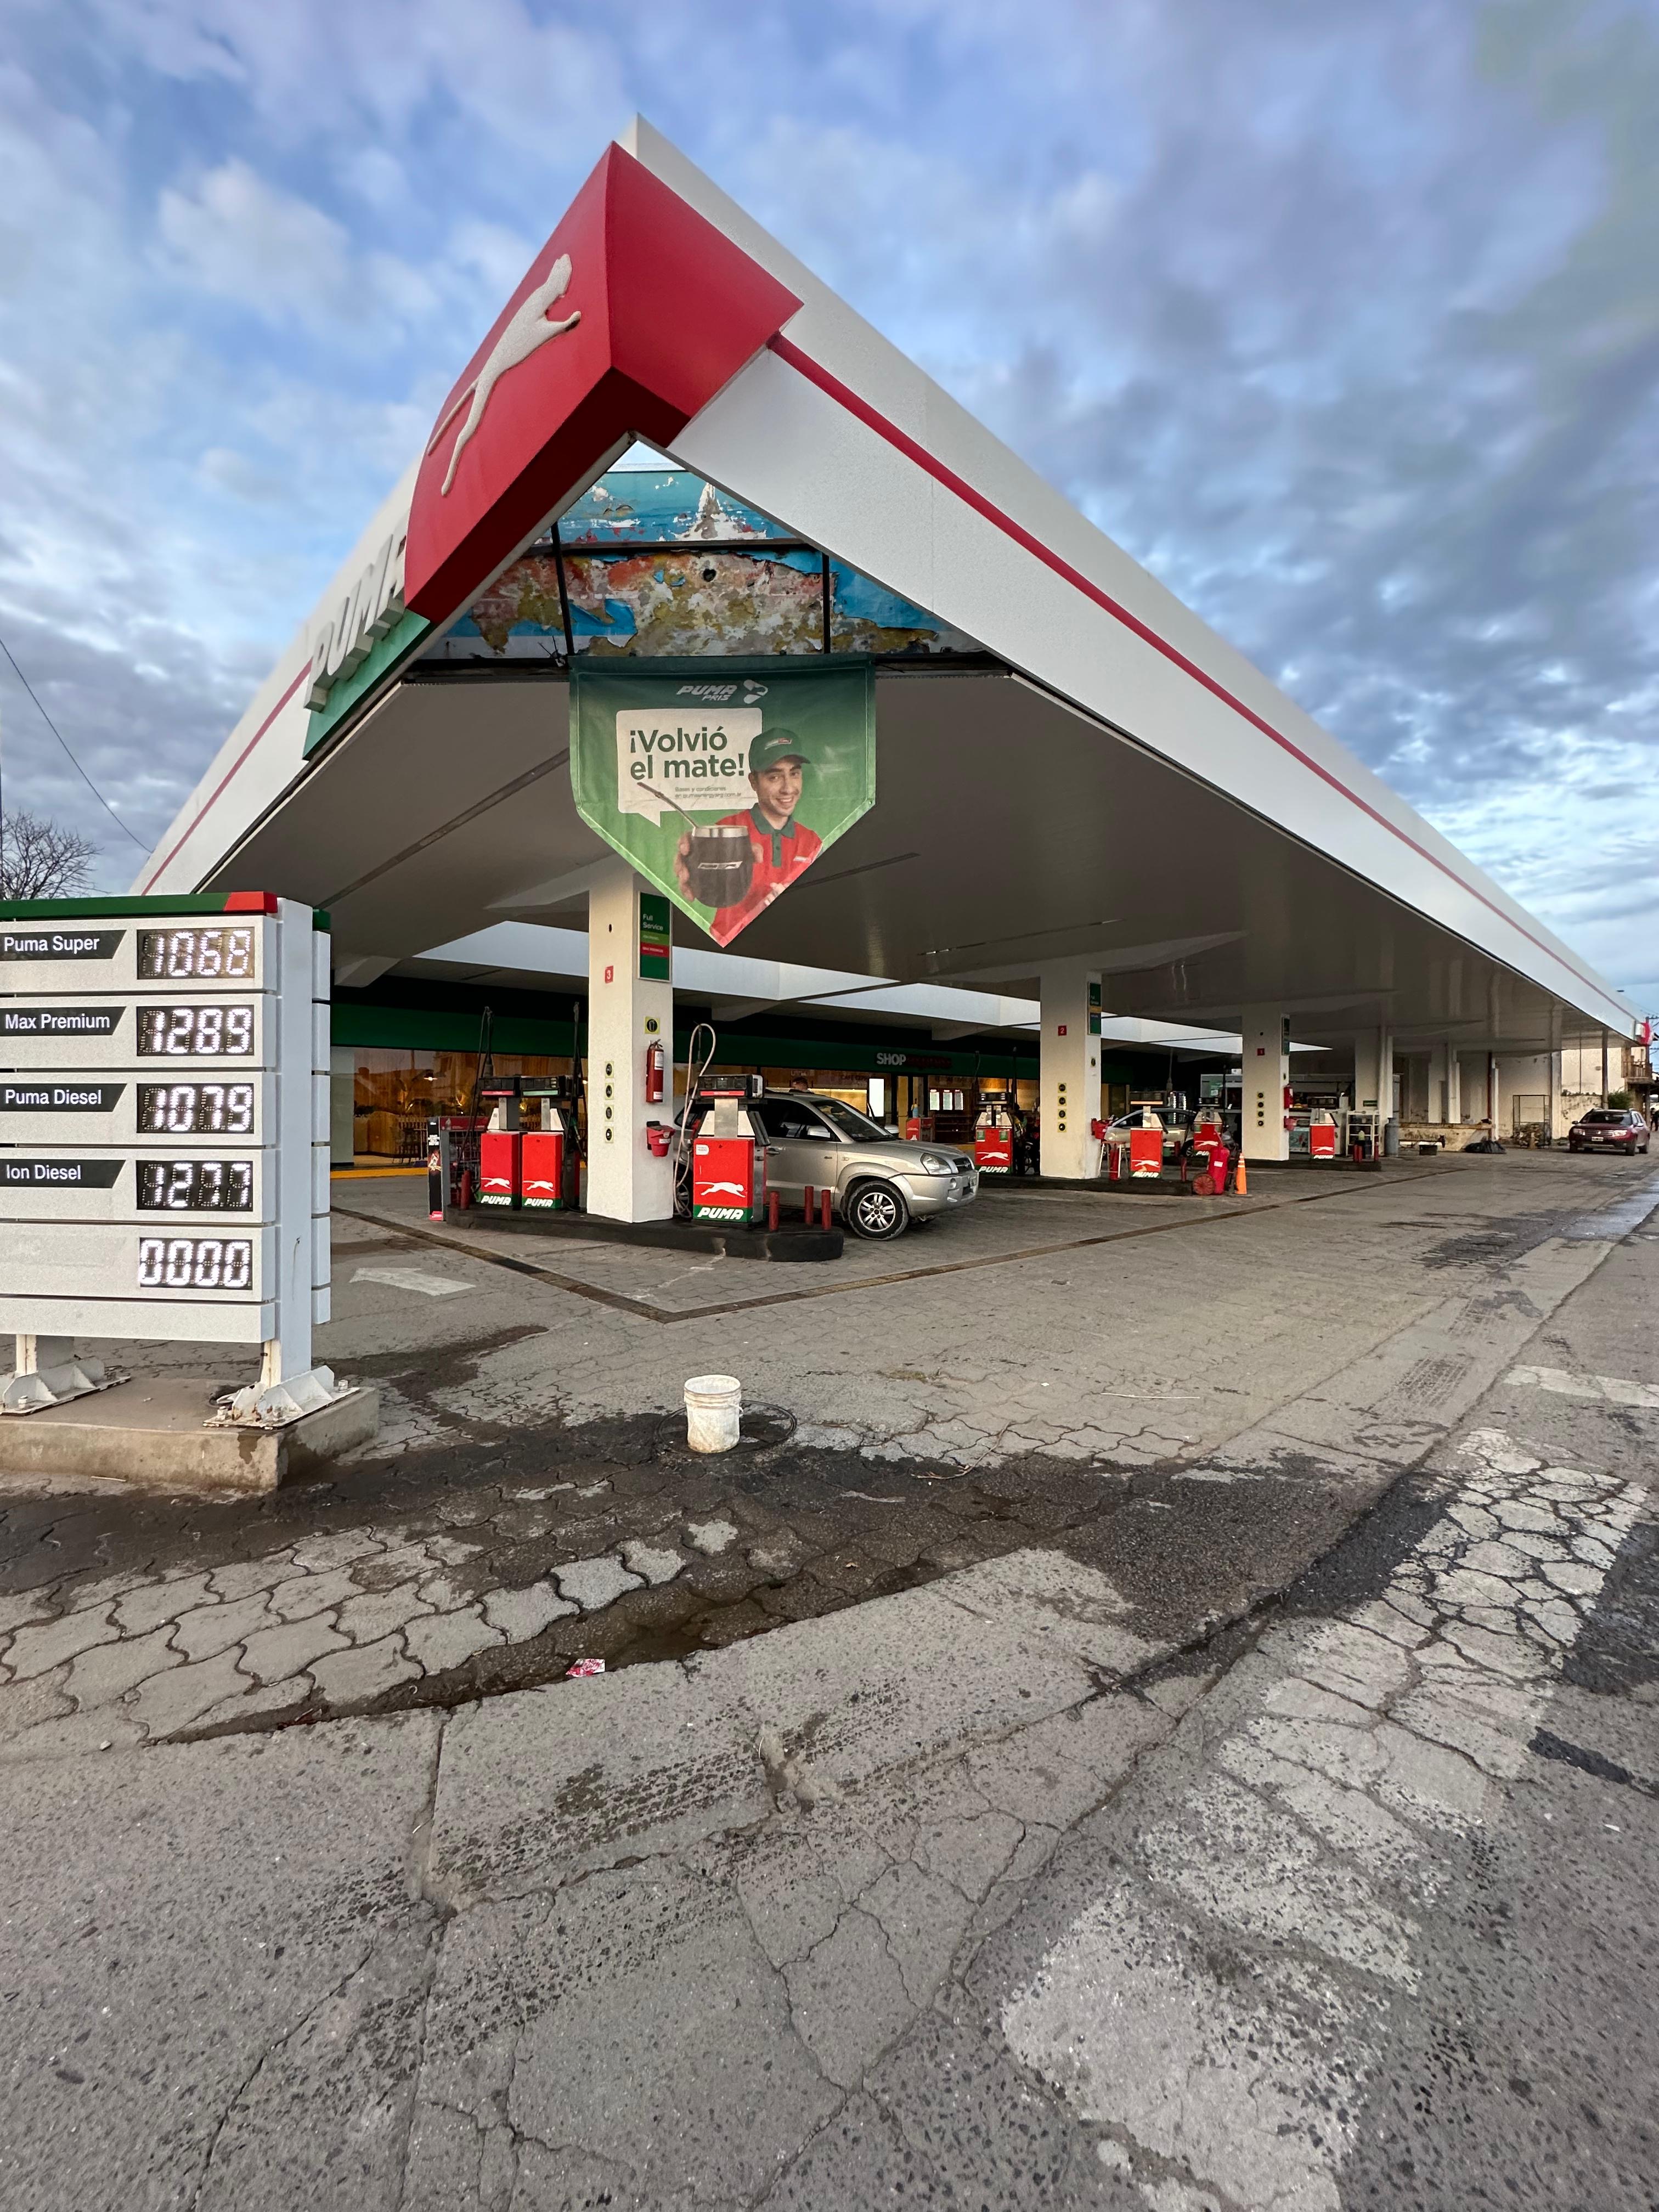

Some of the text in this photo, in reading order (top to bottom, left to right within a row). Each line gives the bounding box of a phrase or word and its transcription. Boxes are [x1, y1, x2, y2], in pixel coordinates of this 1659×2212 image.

[676, 685, 737, 695] PUMA
[630, 726, 727, 753] ¡Volvió
[630, 753, 744, 780] el mate!
[643, 922, 663, 931] Service
[4, 935, 100, 954] Puma Super
[154, 930, 251, 977] 1068
[607, 969, 611, 980] 3
[5, 1013, 110, 1029] Max Premium
[153, 1009, 251, 1053] 1289
[877, 1053, 906, 1065] SHOP
[5, 1089, 101, 1104] Puma Diesel
[154, 1086, 252, 1131] 1079
[7, 1164, 81, 1180] Ion Diesel
[154, 1163, 251, 1207] 1277
[481, 1195, 511, 1205] PUMA
[524, 1198, 554, 1207] PUMA
[697, 1207, 744, 1220] PUMA
[138, 1239, 250, 1287] 0000
